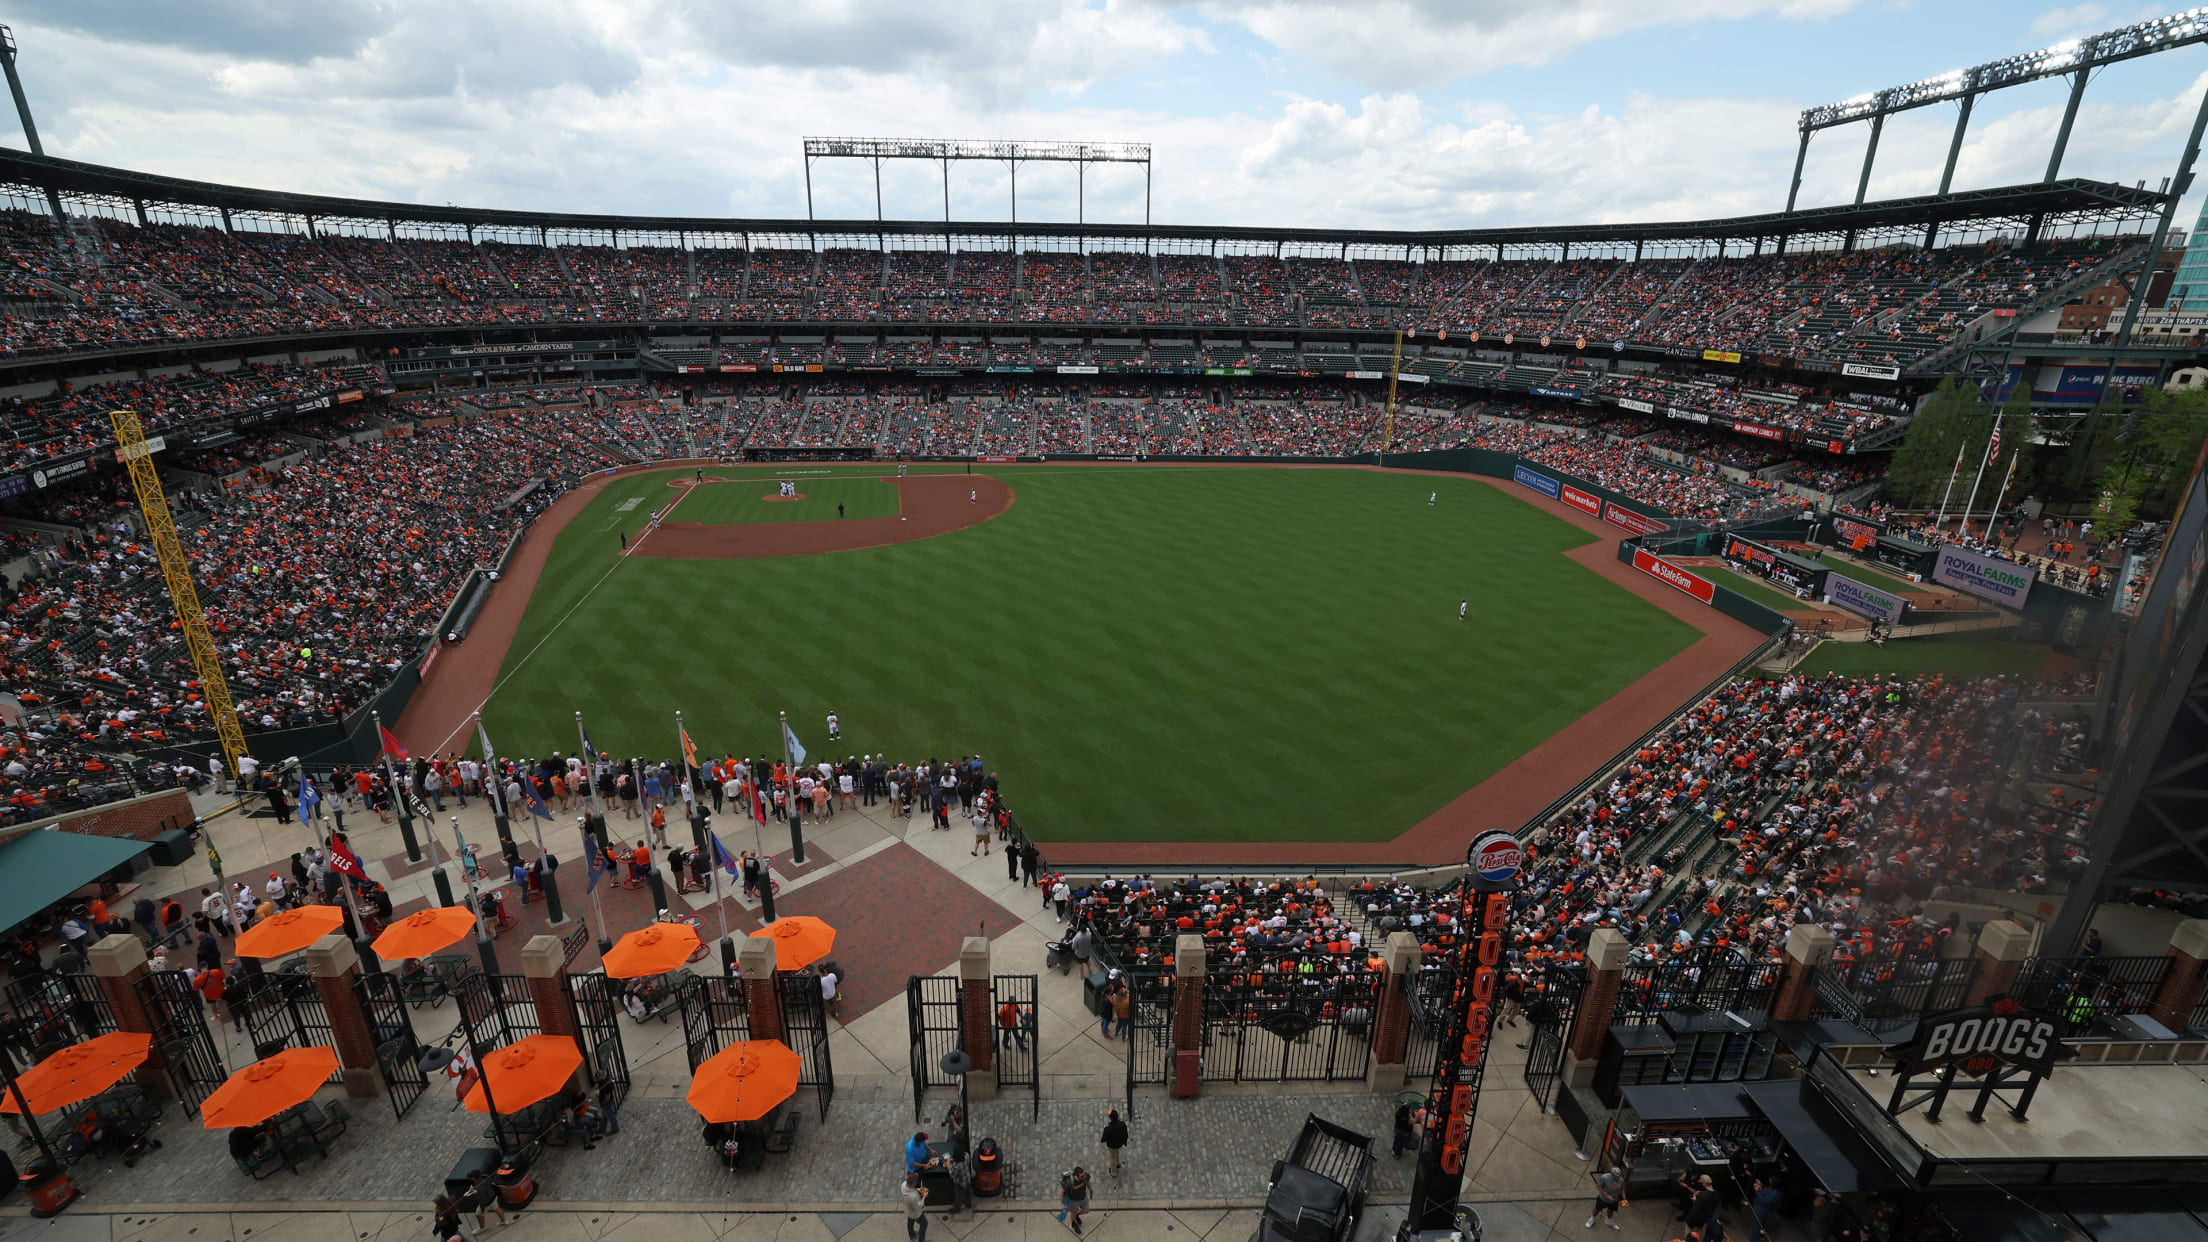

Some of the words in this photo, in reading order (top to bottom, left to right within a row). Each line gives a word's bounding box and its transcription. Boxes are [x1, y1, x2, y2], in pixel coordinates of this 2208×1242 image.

[498, 345, 516, 353] PARK
[522, 344, 551, 352] CAMDEN
[1665, 347, 1684, 356] GANZ
[1848, 365, 1870, 374] WBAL
[2092, 375, 2126, 384] PINIC
[1516, 469, 1537, 485] LECOM
[1564, 490, 1575, 499] weis
[1575, 495, 1597, 510] markets
[417, 803, 431, 817] SOX
[331, 850, 352, 871] GELS
[1834, 994, 1846, 1007] OUT
[1846, 1004, 1858, 1017] FOR
[1837, 1003, 1855, 1021] BALLS
[1966, 1056, 1995, 1070] BBQ
[1441, 1083, 1472, 1176] BBQ
